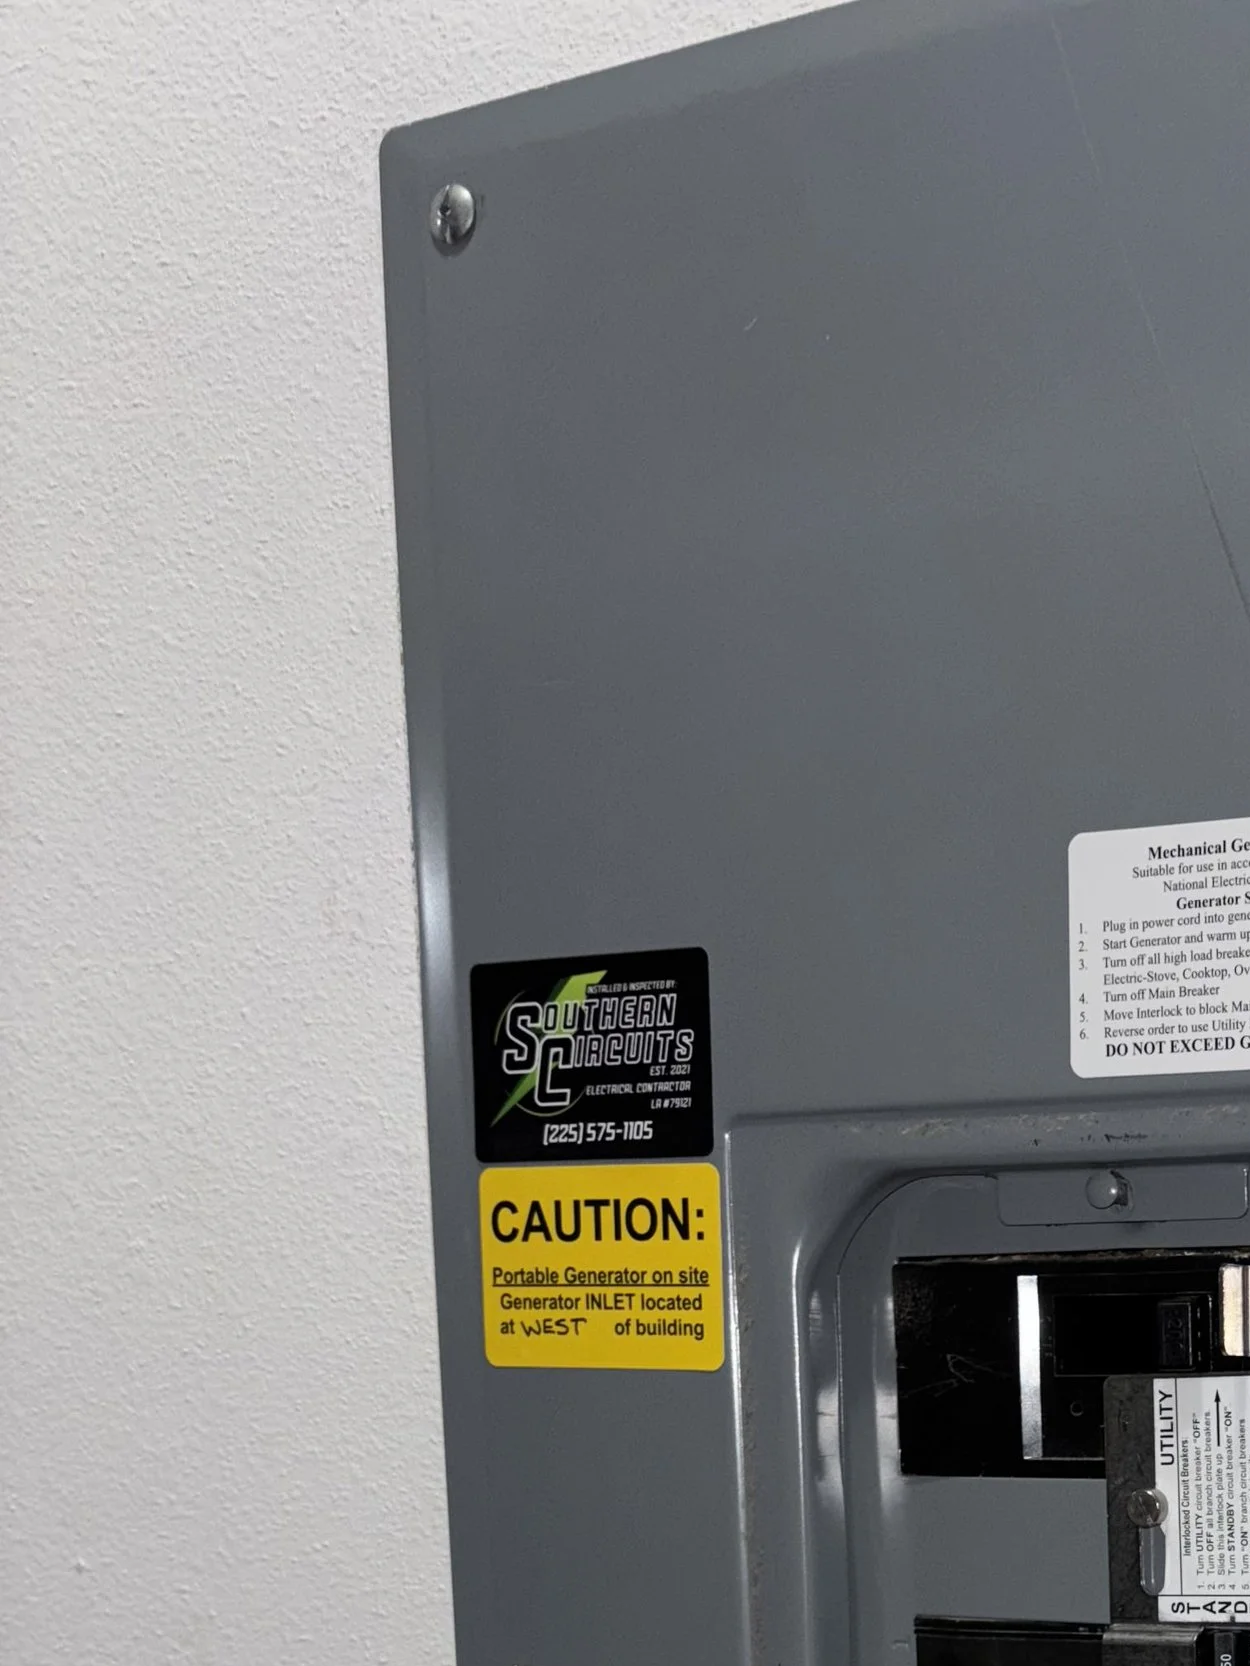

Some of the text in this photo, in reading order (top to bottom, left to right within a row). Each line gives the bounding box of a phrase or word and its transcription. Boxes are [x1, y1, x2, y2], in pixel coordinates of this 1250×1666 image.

[1147, 839, 1227, 861] Mechanical
[1132, 863, 1175, 879] Suitable
[1178, 862, 1194, 875] for
[1196, 862, 1215, 873] use
[1216, 858, 1228, 872] in
[1163, 876, 1208, 893] National
[1176, 894, 1242, 911] Generator
[1102, 919, 1127, 934] Plug
[1129, 919, 1140, 931] in
[1141, 918, 1176, 932] power
[1177, 912, 1201, 927] cord
[1203, 912, 1225, 925] into
[1103, 970, 1180, 986] Electric-Stove,
[1182, 966, 1231, 981] Cooktop,
[587, 983, 622, 994] INSTALLED
[628, 981, 664, 991] INSPECTED
[1102, 990, 1128, 1003] Turn
[1129, 987, 1147, 1001] off
[1148, 987, 1176, 1000] Main
[1178, 983, 1221, 998] Breaker
[1103, 1008, 1134, 1022] Move
[1136, 1004, 1183, 1020] Interlock
[1185, 1005, 1197, 1016] to
[1198, 1001, 1229, 1016] block
[502, 993, 677, 1074] SOUTHERN
[1105, 1042, 1129, 1058] DO
[1132, 1039, 1167, 1056] NOT
[1169, 1035, 1236, 1054] EXCEED
[534, 1029, 694, 1107] CIRCUITS
[650, 1064, 691, 1075] EST. 2021
[585, 1081, 691, 1096] ELECTRICAL CONTRACTOR
[651, 1099, 661, 1109] LA
[543, 1121, 653, 1145] (225) 575-1105
[491, 1197, 704, 1242] CAUTION:
[493, 1267, 709, 1285] Portable Generator on site
[500, 1293, 702, 1311] Generator INLET located
[500, 1318, 704, 1340] at WEST of building
[1157, 1388, 1176, 1467] UTILITY
[1193, 1445, 1203, 1482] breaker
[1180, 1478, 1191, 1509] Circuit
[1194, 1483, 1204, 1512] circuit
[1181, 1509, 1192, 1557] Interlocked
[1194, 1513, 1205, 1553] UTILITY
[1195, 1554, 1205, 1577] Turn
